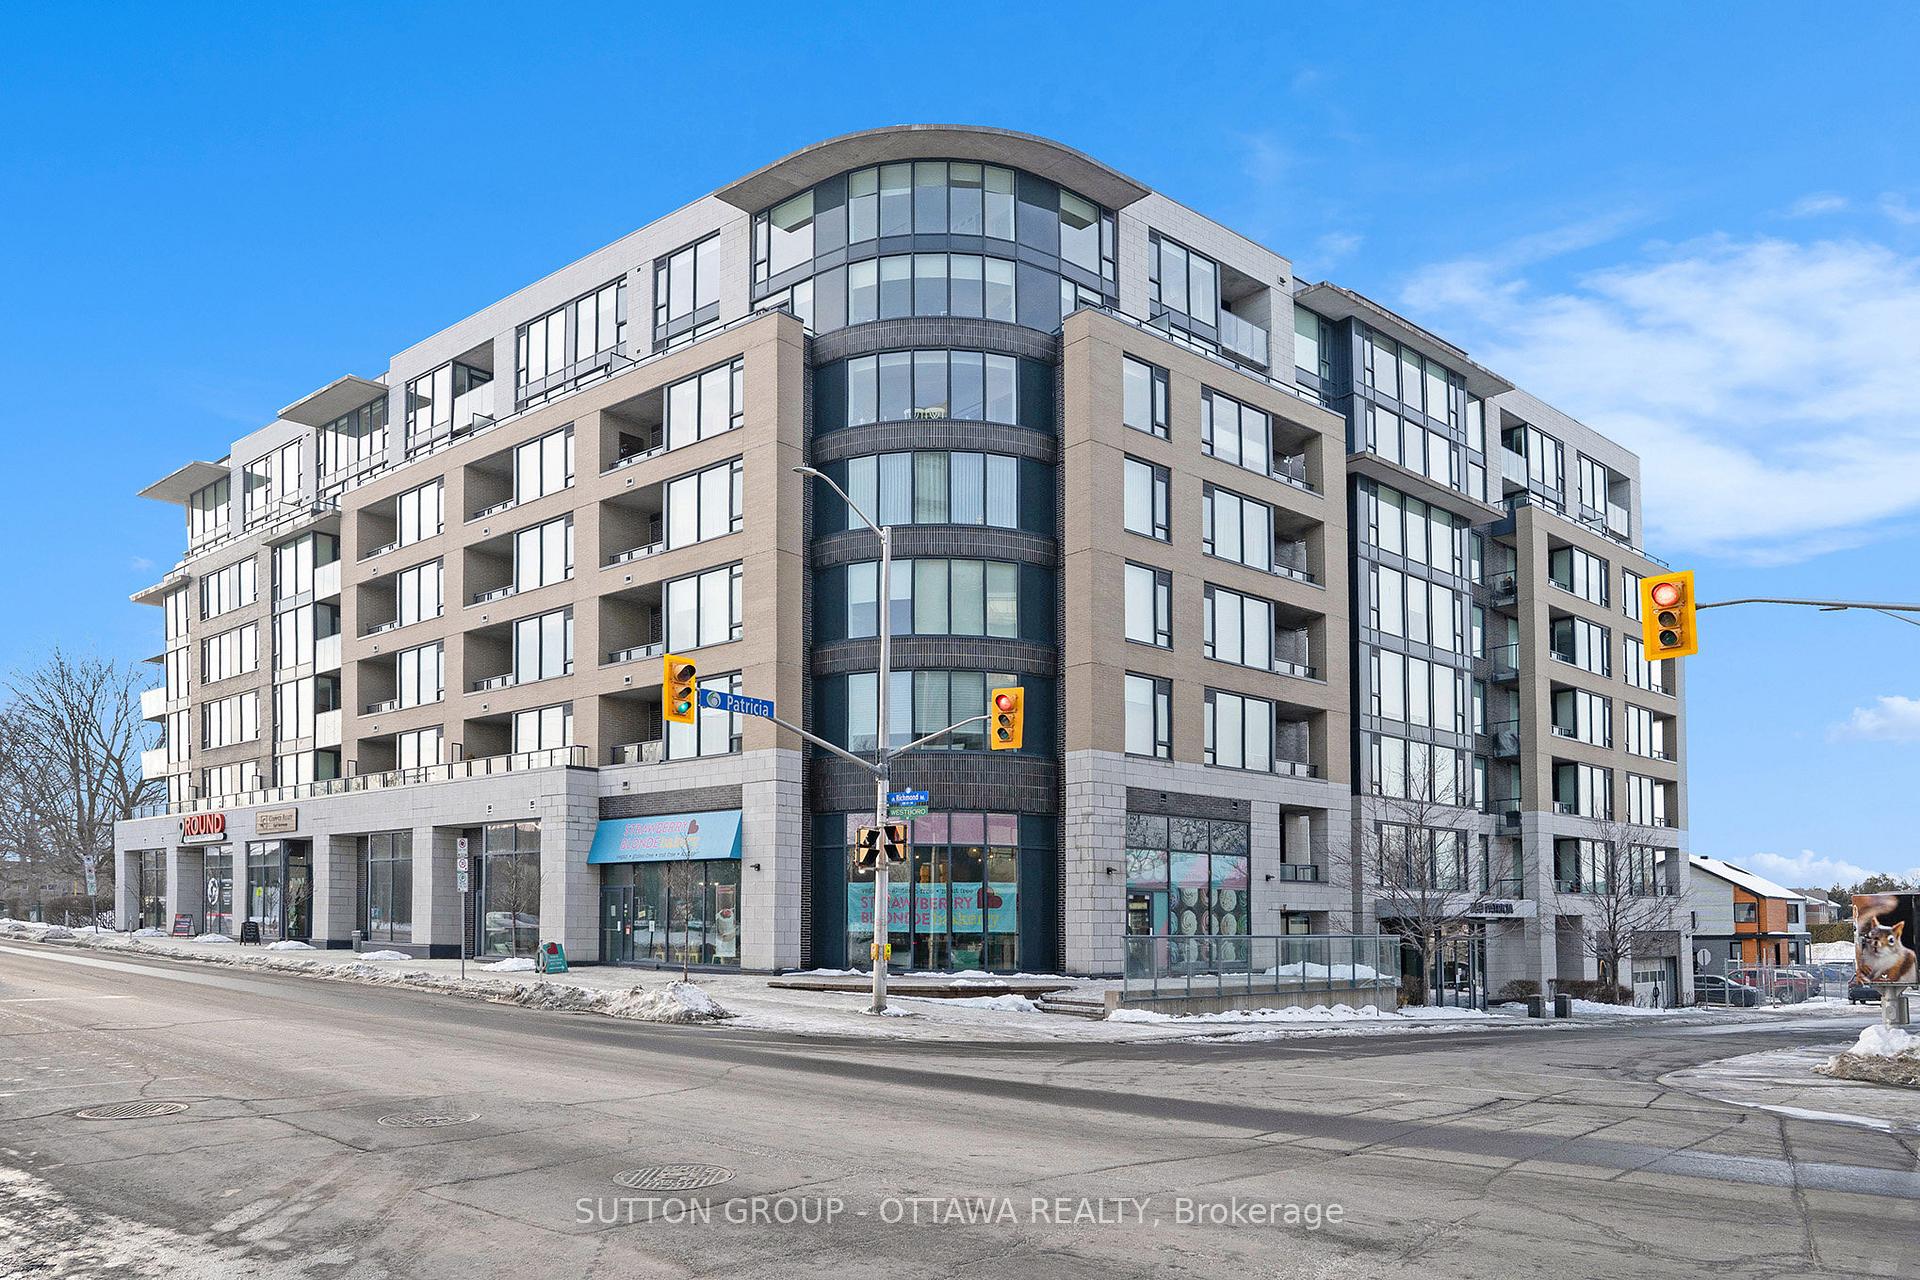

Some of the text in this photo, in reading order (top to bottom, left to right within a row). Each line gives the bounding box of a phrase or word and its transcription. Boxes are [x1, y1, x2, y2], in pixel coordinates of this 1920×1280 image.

[727, 695, 769, 717] Patricia
[896, 793, 919, 801] Richmond
[861, 896, 973, 909] STAWBERRY
